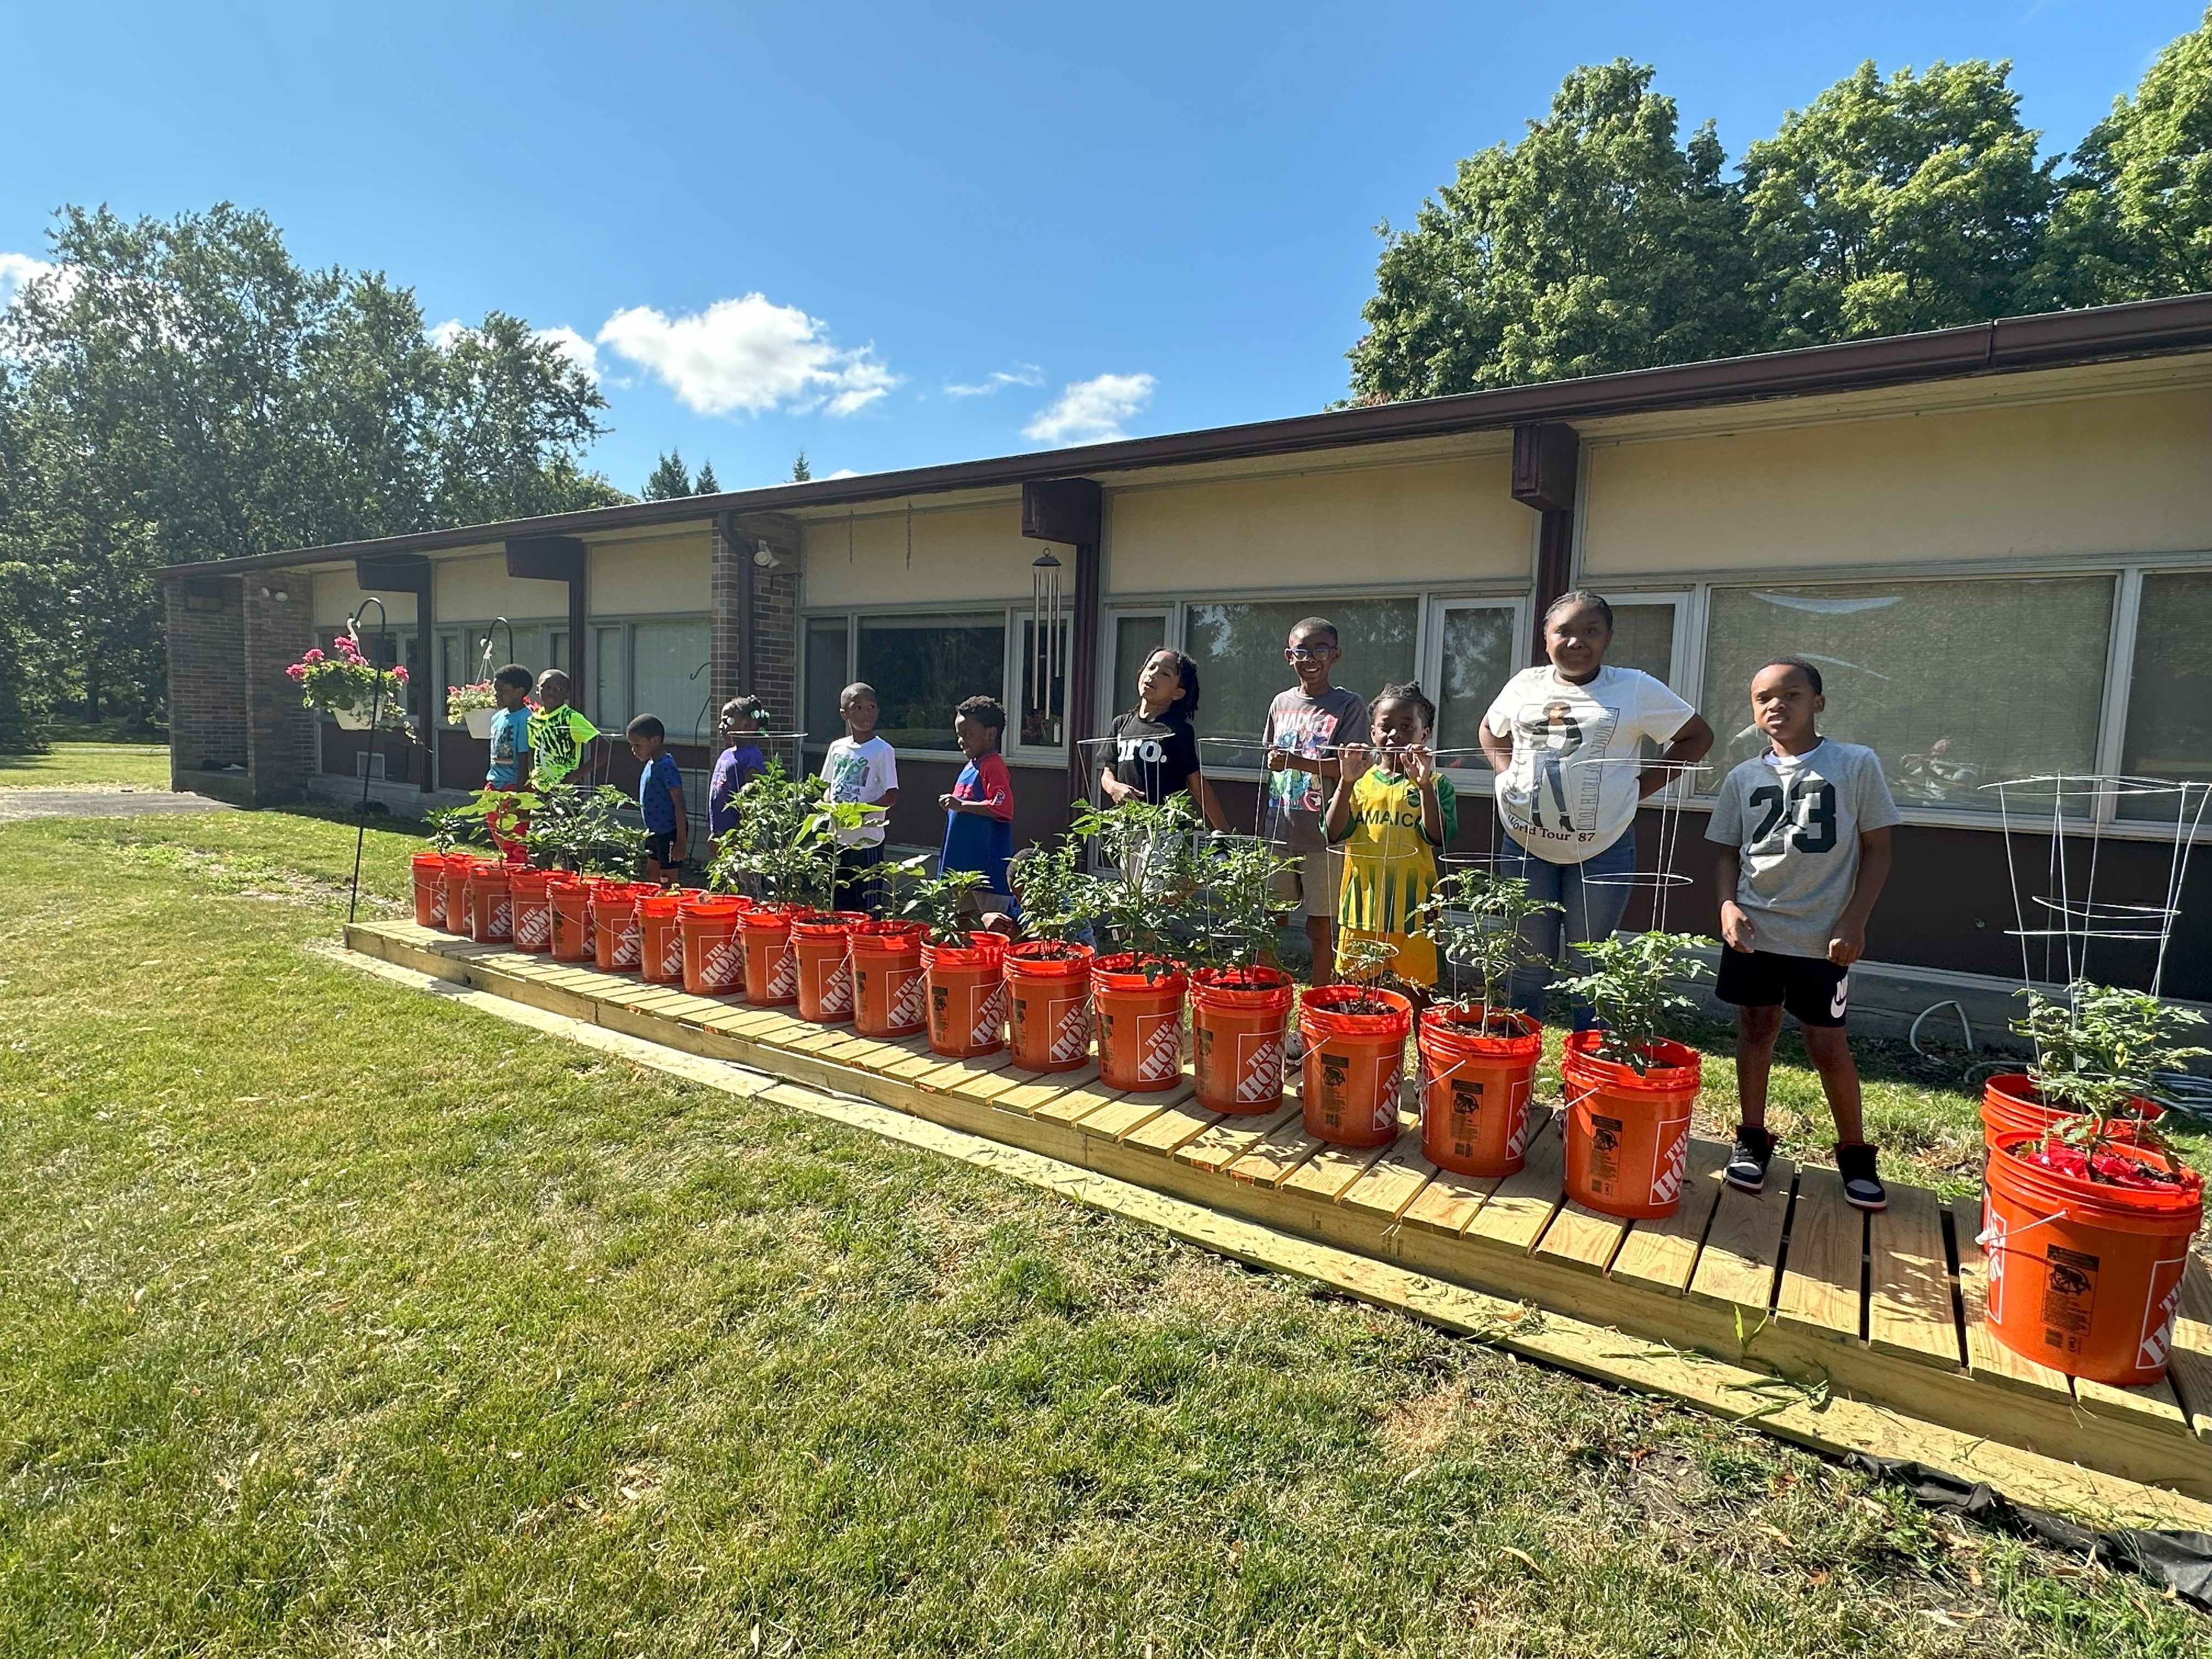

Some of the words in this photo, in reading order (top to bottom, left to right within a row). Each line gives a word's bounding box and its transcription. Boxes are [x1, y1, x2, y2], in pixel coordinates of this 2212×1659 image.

[1580, 776, 1599, 805] TRUTH
[1508, 814, 1536, 836] World
[1539, 827, 1571, 841] Tour
[1576, 808, 1595, 829] TOUR
[1746, 780, 1837, 856] 23
[520, 906, 538, 924] THE
[704, 941, 727, 961] THE
[825, 966, 850, 986] THE
[893, 975, 917, 998] THE
[889, 979, 926, 1026] HOM
[1056, 1005, 1081, 1031] THE
[1050, 1008, 1090, 1060] HOM
[1145, 1020, 1172, 1048] THE
[1139, 1017, 1183, 1080] HOM
[1246, 1040, 1274, 1069] THE
[1238, 1035, 1285, 1101] HOM
